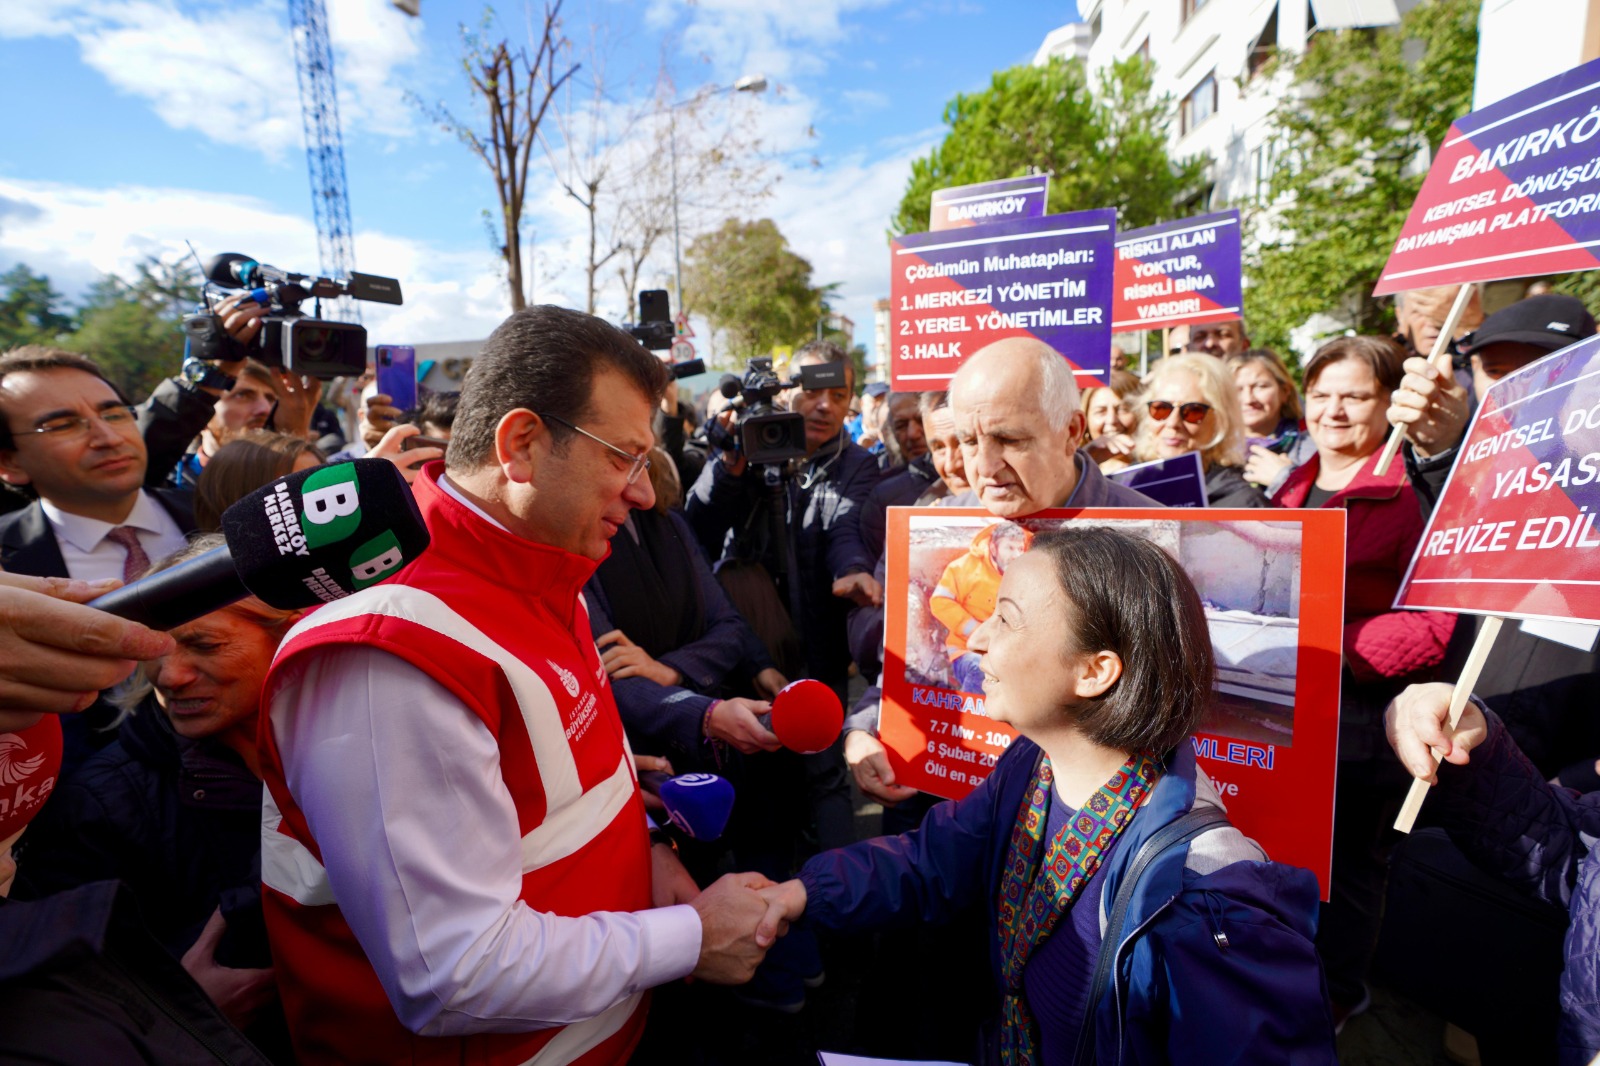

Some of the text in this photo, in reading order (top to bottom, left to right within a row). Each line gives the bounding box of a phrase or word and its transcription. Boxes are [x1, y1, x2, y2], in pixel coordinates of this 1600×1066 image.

[1422, 157, 1600, 224] KENTSEL DÖNÜŞÜ
[947, 196, 1026, 222] BAKIRKÖY
[1119, 228, 1216, 261] RİSKLİ ALAN
[1395, 218, 1487, 254] DAYANIŞMA
[905, 248, 1095, 283] Çözümün Muhatapları:
[1132, 254, 1202, 279] YOKTUR,
[997, 278, 1086, 302] YÖNETİM
[1123, 274, 1215, 301] RİSKLİ BİNA
[975, 307, 1103, 331] YÖNETİMLER
[1137, 298, 1200, 319] VARDIR!
[1463, 417, 1554, 465] KENTSEL
[1492, 452, 1600, 499] YASAS
[263, 493, 293, 556] MERKEZ
[274, 481, 310, 556] BAKIRKÖY
[1423, 517, 1517, 557] REVİZE
[930, 719, 949, 734] 7.7
[952, 724, 975, 740] Mw
[927, 741, 1000, 768] 6 Şubat 20
[925, 760, 947, 778] Ölü
[949, 771, 966, 783] en
